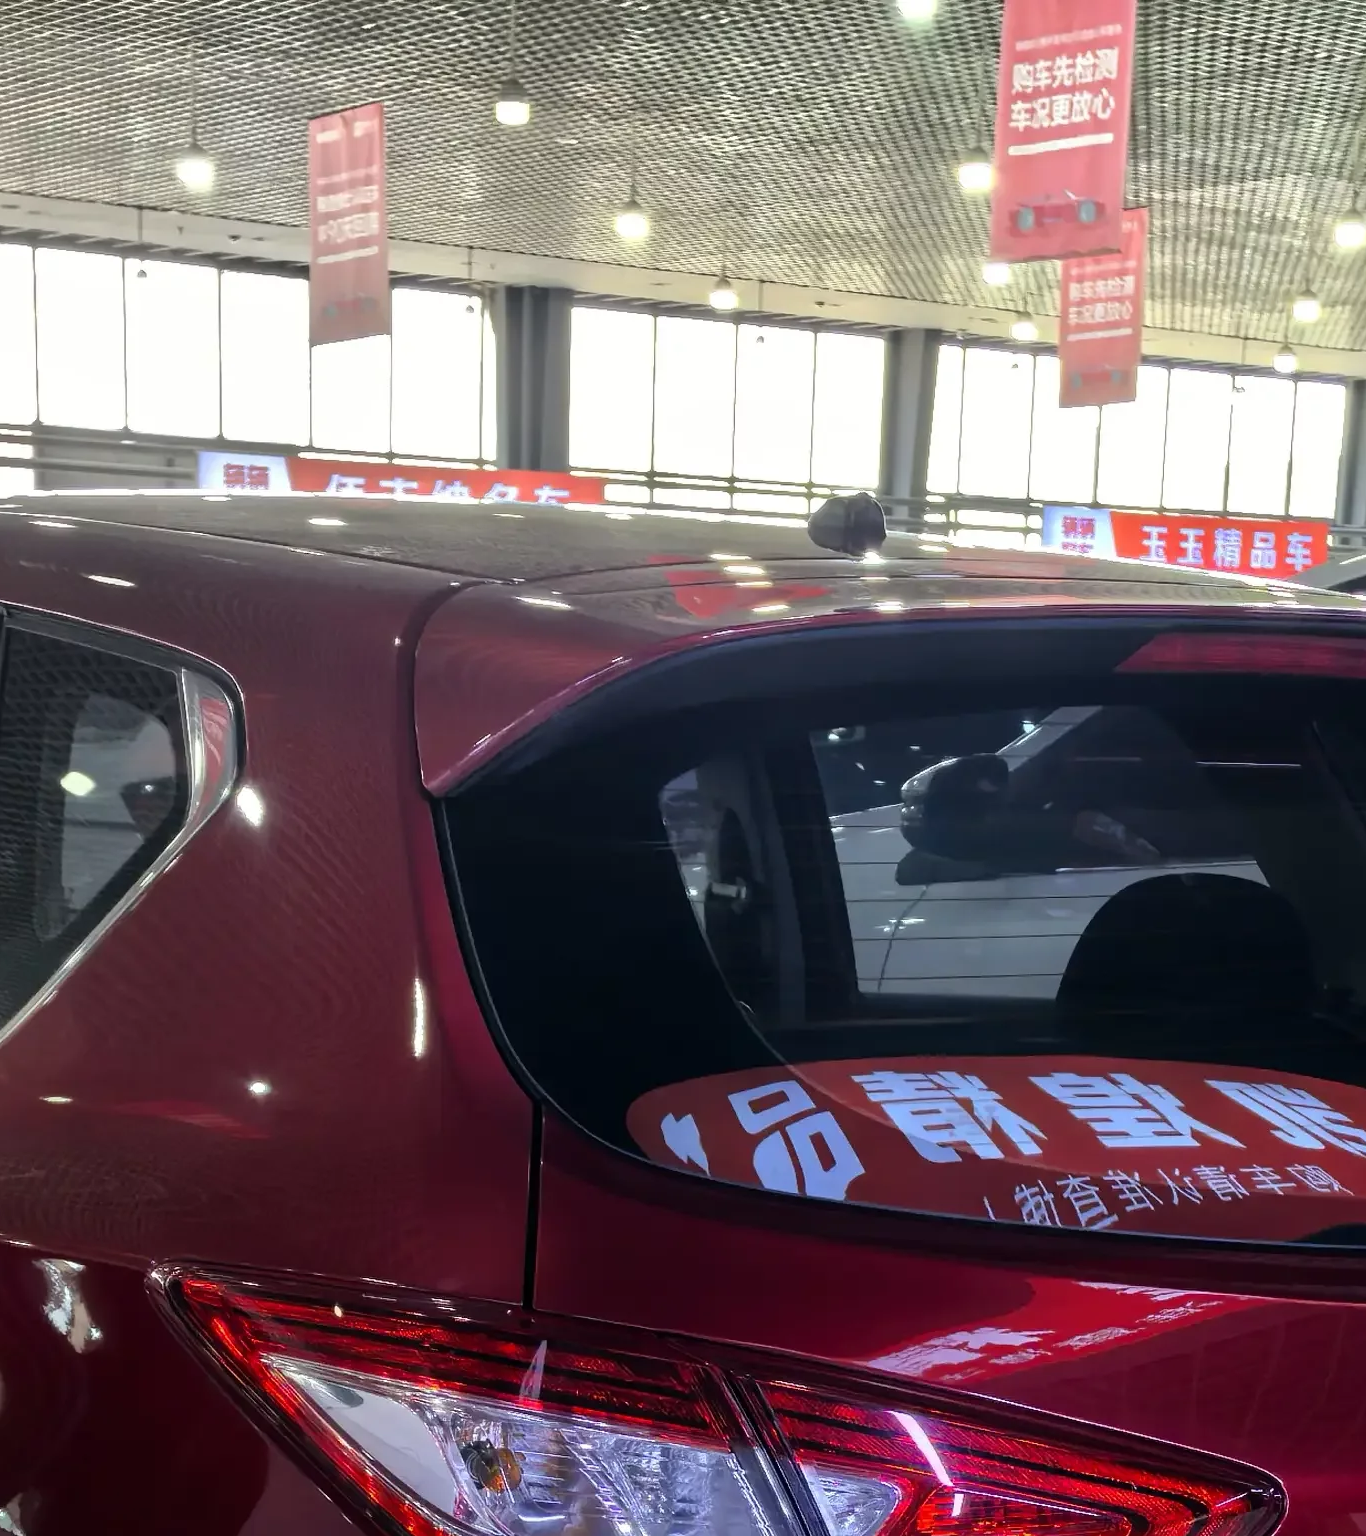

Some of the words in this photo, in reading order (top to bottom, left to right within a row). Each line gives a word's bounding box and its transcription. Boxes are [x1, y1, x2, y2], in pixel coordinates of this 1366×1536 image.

[1011, 47, 1119, 95] 购车先检测
[1008, 88, 1115, 132] 车况更放心
